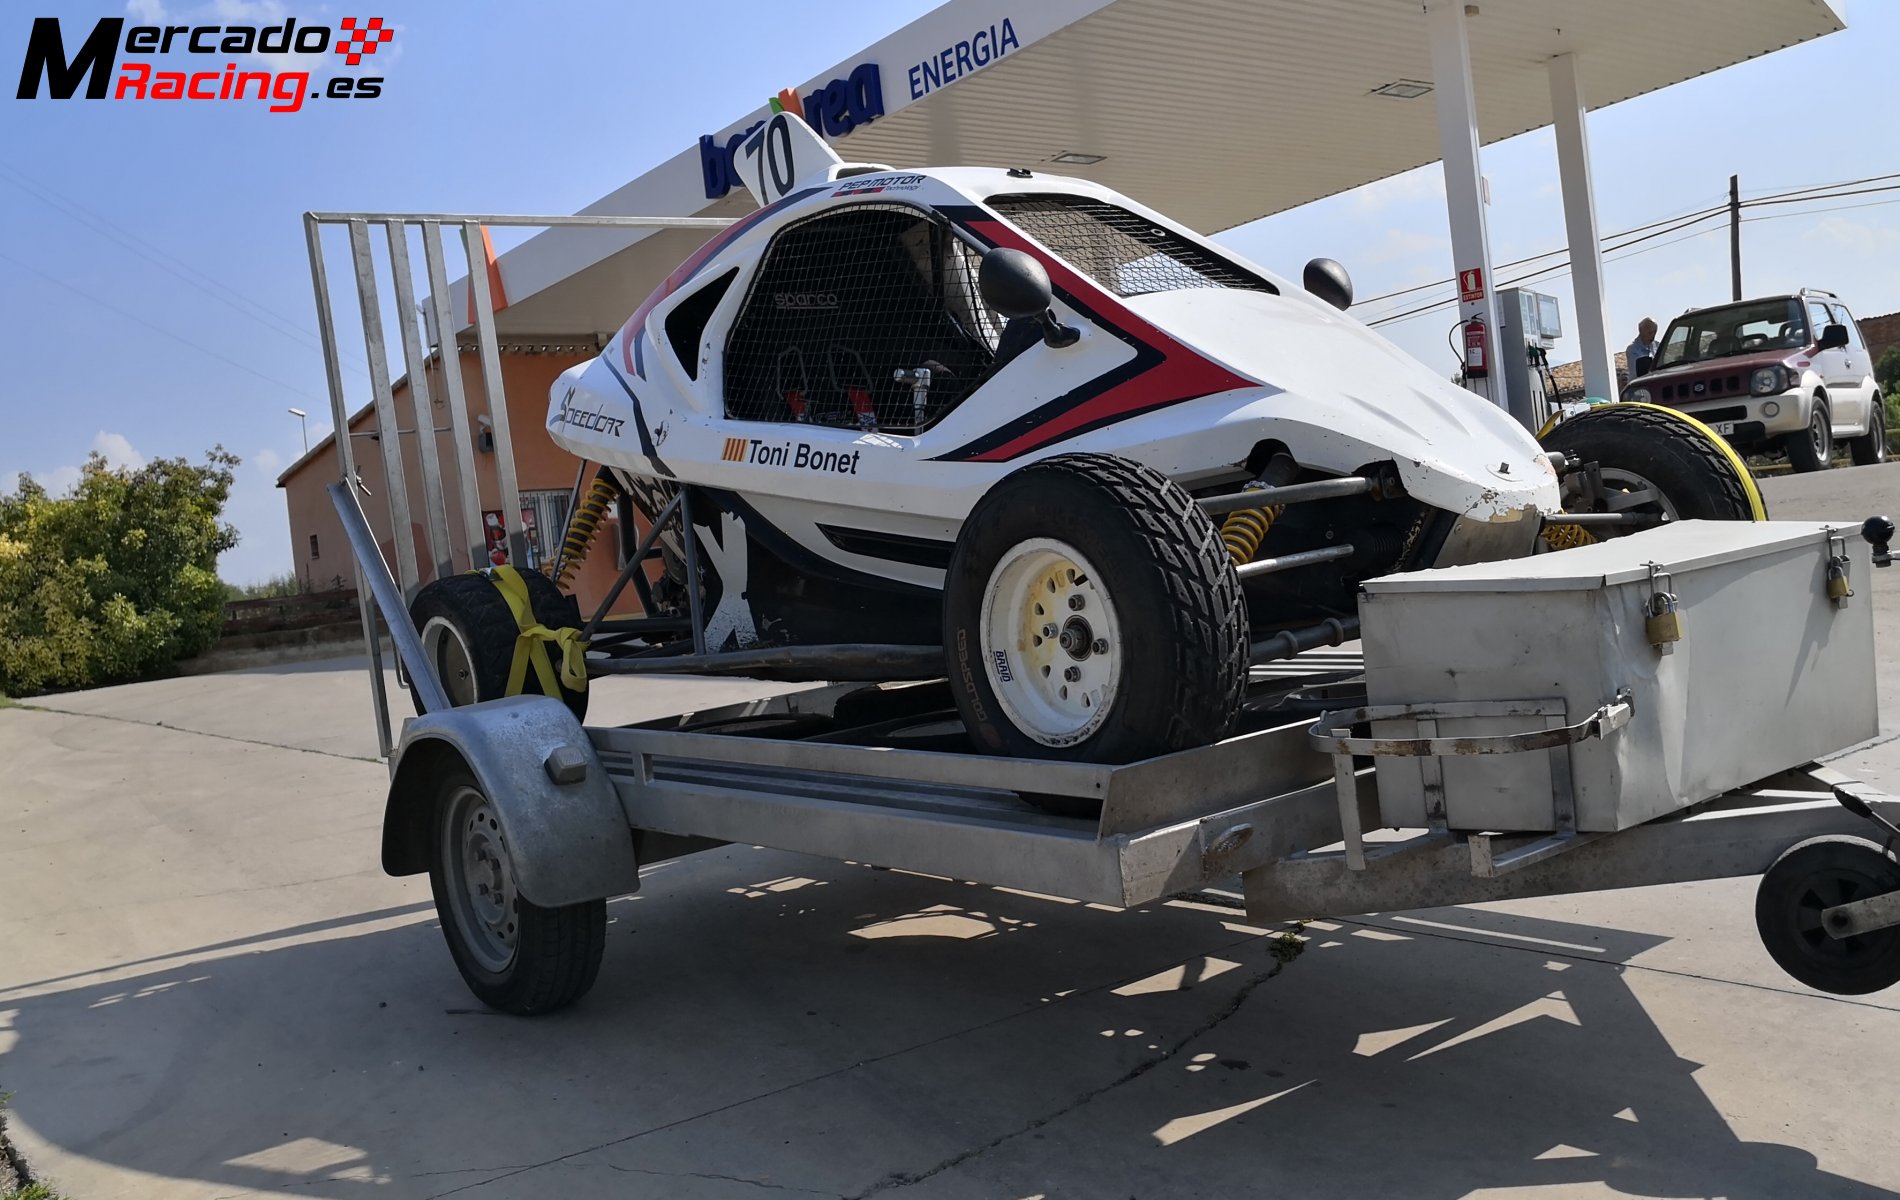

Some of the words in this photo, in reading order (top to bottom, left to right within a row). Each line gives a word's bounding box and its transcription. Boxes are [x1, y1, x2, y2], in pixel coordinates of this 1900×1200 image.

[908, 17, 1020, 101] ENERGIA
[745, 114, 795, 206] 70
[838, 175, 927, 190] PEPMOTOR
[774, 293, 838, 309] sparco
[750, 439, 790, 466] Toni
[794, 443, 860, 475] Bonet
[957, 628, 988, 721] GOLDSPEED
[995, 651, 1012, 682] BRAID
